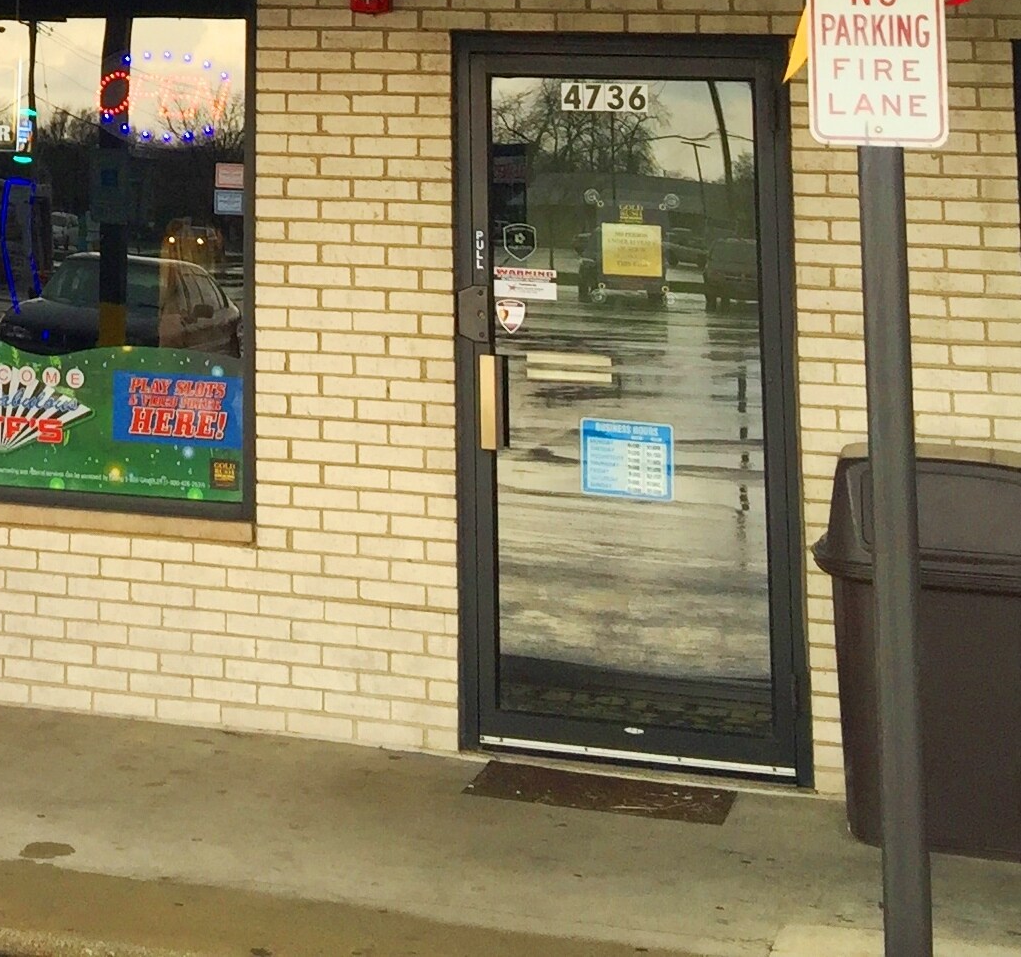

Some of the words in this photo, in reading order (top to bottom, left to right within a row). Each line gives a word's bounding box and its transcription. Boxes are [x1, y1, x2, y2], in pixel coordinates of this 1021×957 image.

[820, 13, 931, 49] PARKING
[832, 58, 922, 83] FIRE
[562, 85, 647, 112] 4736
[828, 93, 928, 118] LANE
[475, 230, 485, 270] PULL
[496, 269, 554, 279] WARNING
[129, 377, 172, 396] PLAY
[175, 380, 227, 399] SLOTS
[128, 405, 228, 441] HERE!
